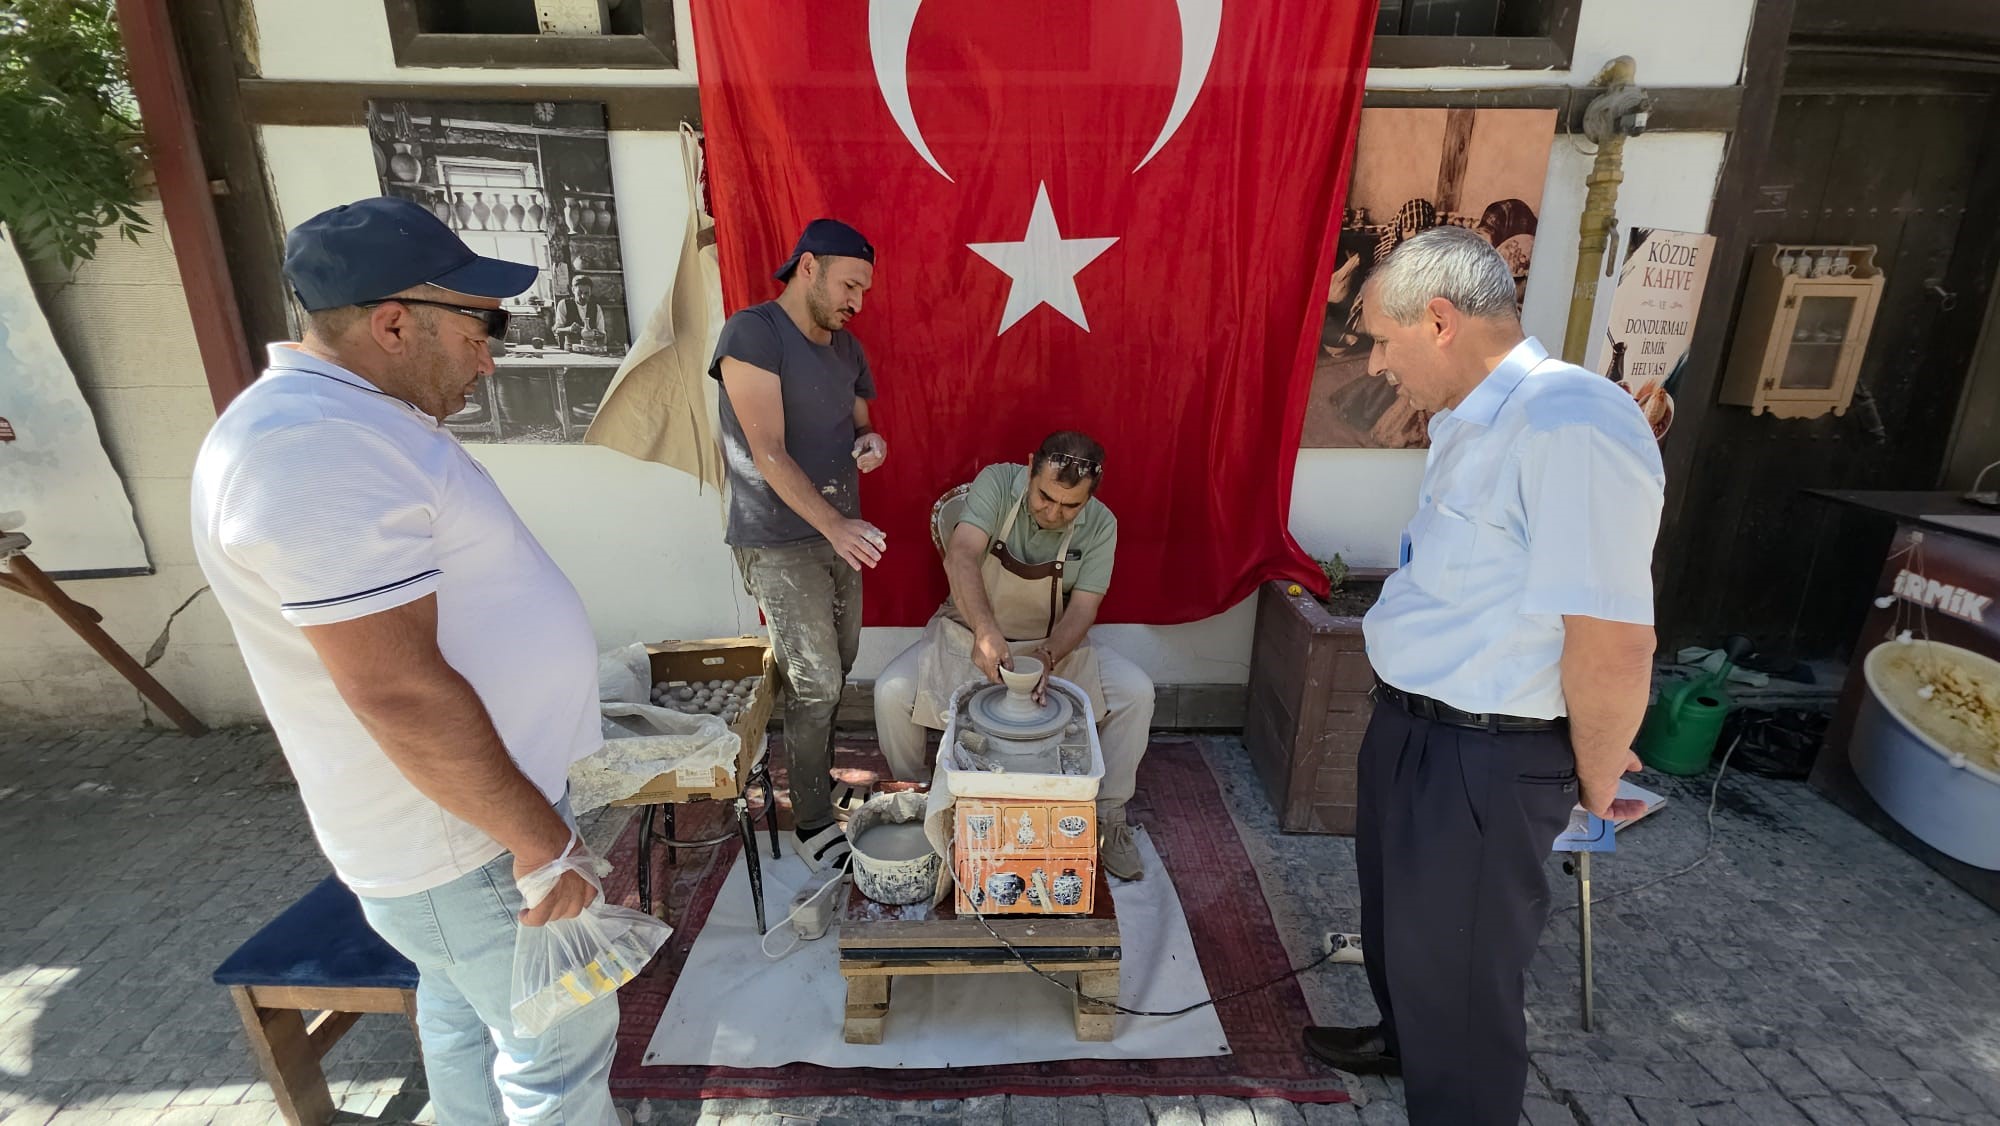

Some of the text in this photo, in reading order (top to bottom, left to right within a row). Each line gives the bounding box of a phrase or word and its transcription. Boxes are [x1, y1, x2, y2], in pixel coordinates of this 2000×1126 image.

[1648, 240, 1698, 267] KÖZDE
[1642, 267, 1693, 291] KAHVE
[1625, 319, 1688, 335] DONDURMALI
[1641, 338, 1667, 354] İRMİK
[1631, 362, 1667, 375] HELVASI
